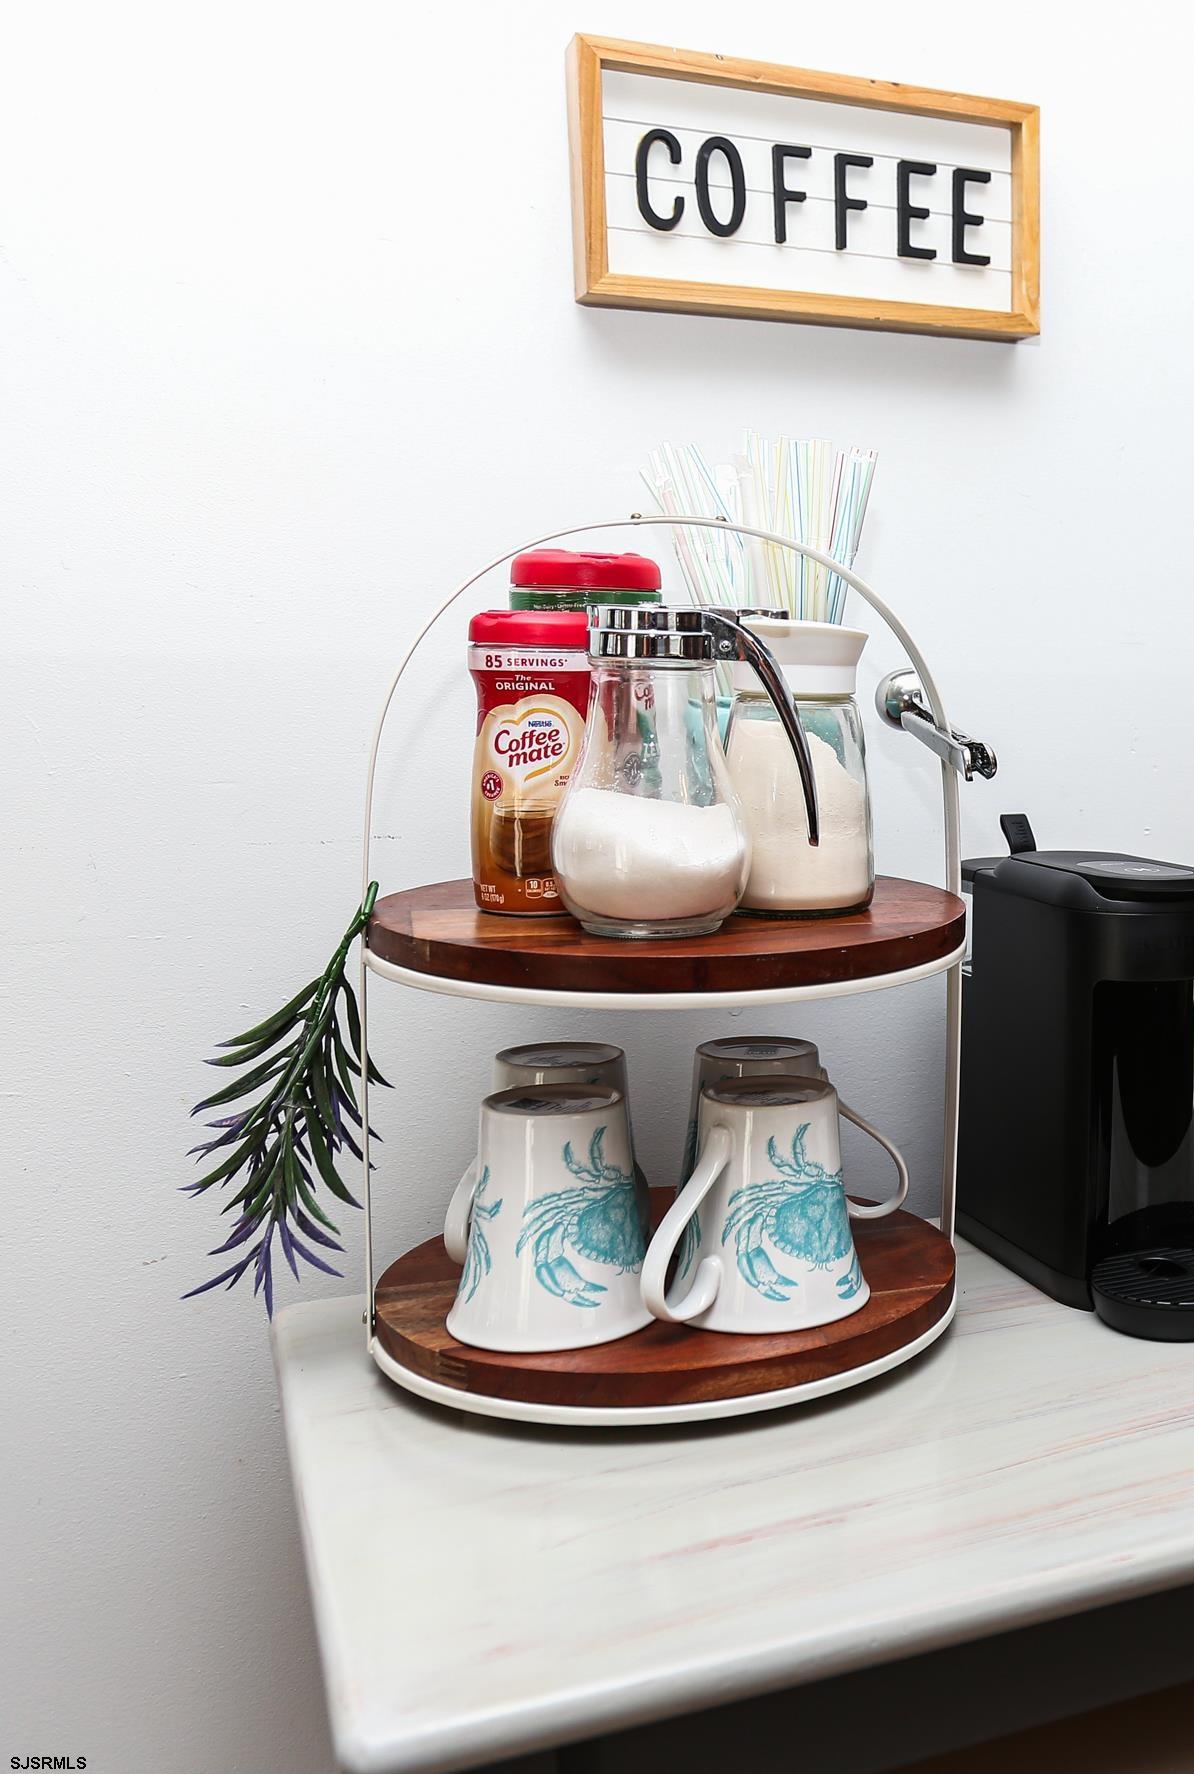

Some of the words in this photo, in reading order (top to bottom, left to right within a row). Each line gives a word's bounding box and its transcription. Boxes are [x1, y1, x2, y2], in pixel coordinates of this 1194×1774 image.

[636, 128, 990, 265] COFFEE
[485, 654, 503, 668] 85
[496, 682, 556, 690] ORIGINAL
[494, 728, 560, 754] Coffee
[508, 742, 563, 768] mate
[530, 880, 538, 888] 10
